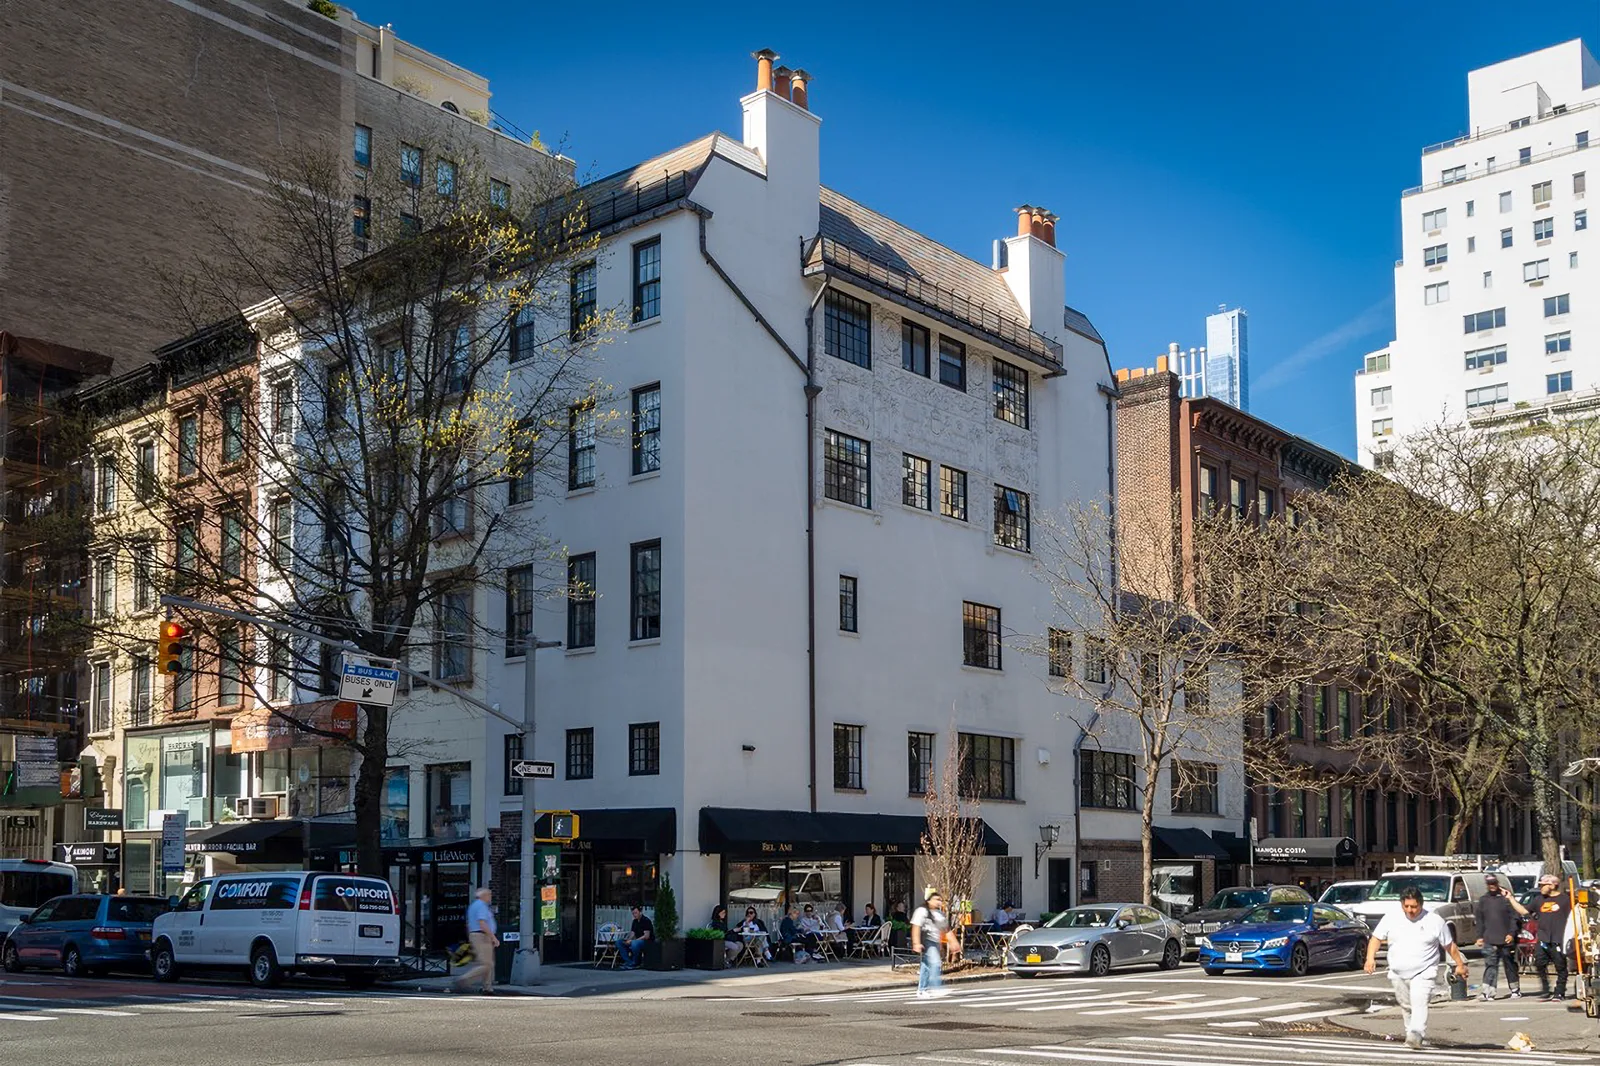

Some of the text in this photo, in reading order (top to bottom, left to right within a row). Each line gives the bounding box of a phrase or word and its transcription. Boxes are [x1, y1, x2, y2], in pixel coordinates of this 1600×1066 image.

[357, 668, 394, 679] BUS LANE
[344, 675, 394, 689] BUSES ONLY
[518, 765, 550, 774] ONE WAY
[226, 843, 245, 851] FACIAL
[245, 843, 257, 851] BAR
[762, 842, 793, 852] BEL AMI
[434, 851, 476, 861] LifeWorx
[219, 882, 273, 898] COMFORT
[335, 886, 388, 899] COMFORT
